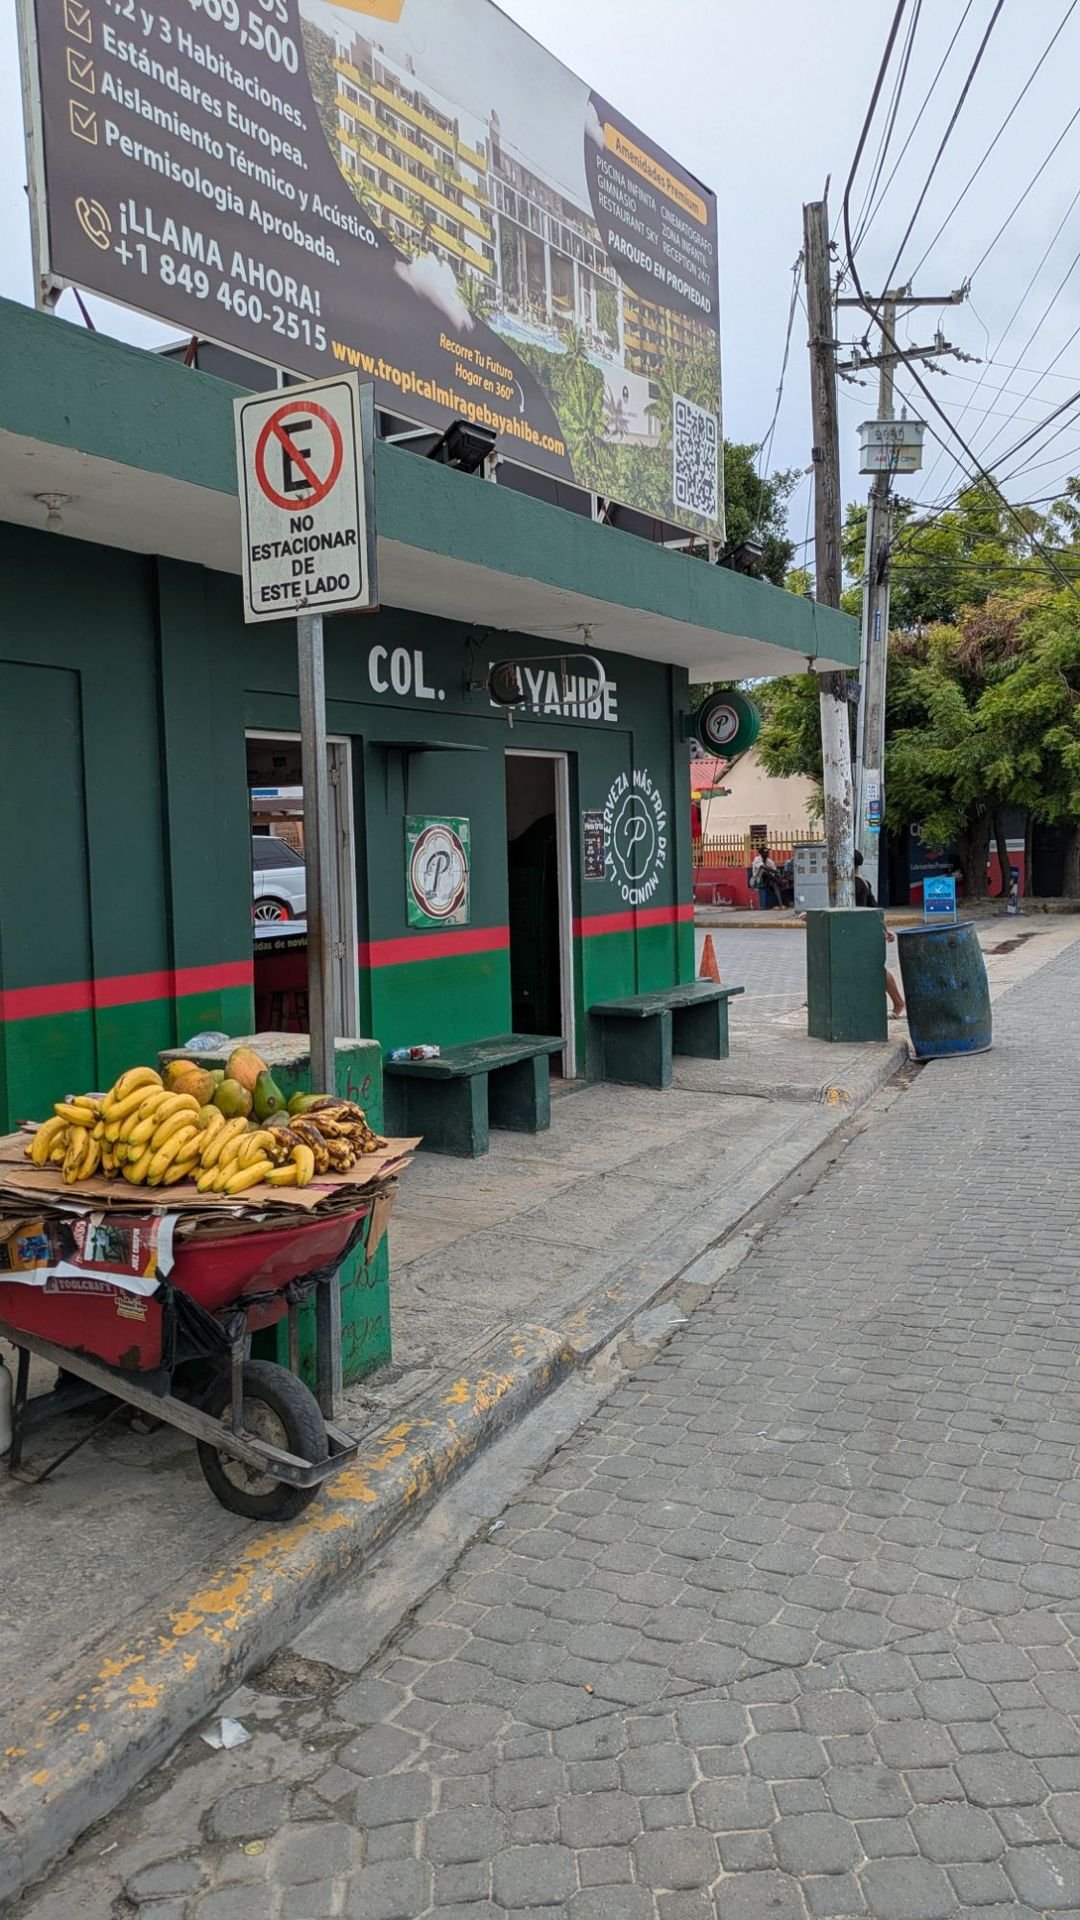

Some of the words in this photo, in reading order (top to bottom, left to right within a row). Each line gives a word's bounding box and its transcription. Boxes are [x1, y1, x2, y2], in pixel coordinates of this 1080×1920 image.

[187, 0, 299, 74] 69,500
[103, 23, 223, 118] Estándares
[226, 100, 308, 170] Europea.
[140, 8, 154, 37] y
[159, 16, 172, 44] 3
[177, 26, 308, 131] Habitaciones.
[101, 71, 224, 158] Aislamiento
[226, 142, 296, 200] Térmico
[298, 188, 310, 212] y
[312, 194, 379, 248] Acústico.
[596, 155, 626, 188] PISCINA
[627, 178, 656, 213] INFINITA
[615, 138, 666, 188] Amenidades
[666, 177, 700, 215] Premium
[104, 119, 244, 216] Permisologia
[249, 199, 342, 266] Aprobada.
[597, 174, 637, 213] GIMNASIO
[598, 191, 645, 236] RESTAURANT
[646, 227, 659, 246] SKY
[119, 199, 224, 272] ¡LLAMA
[231, 251, 321, 317] AHORA!
[608, 230, 652, 273] PARQUEO
[653, 262, 666, 284] EN
[666, 274, 712, 313] PROPIEDAD
[662, 223, 681, 247] ZONA
[681, 238, 708, 269] INFANTIL
[114, 240, 148, 275] +1
[160, 255, 209, 299] 849
[216, 281, 328, 351] 460-2515
[439, 332, 473, 362] Recorre
[474, 350, 485, 368] Tu
[486, 358, 514, 382] Futuro
[455, 362, 482, 390] Hogar
[483, 378, 495, 394] en
[331, 340, 565, 456] www.tropicalmiragebayahibe.com
[251, 529, 356, 562] ESTACIONAR
[289, 515, 314, 534] NO
[260, 580, 302, 602] ESTE
[305, 573, 350, 595] LADO
[291, 557, 315, 577] DE
[368, 645, 445, 700] COL.
[488, 661, 618, 722] YAHIBE
[603, 771, 629, 848] CERVEZA
[632, 768, 653, 796] MÁS
[604, 850, 618, 882] LA
[655, 837, 668, 870] DEL
[621, 871, 660, 905] MUNDO
[59, 1278, 113, 1292] TOOLCRAFT
